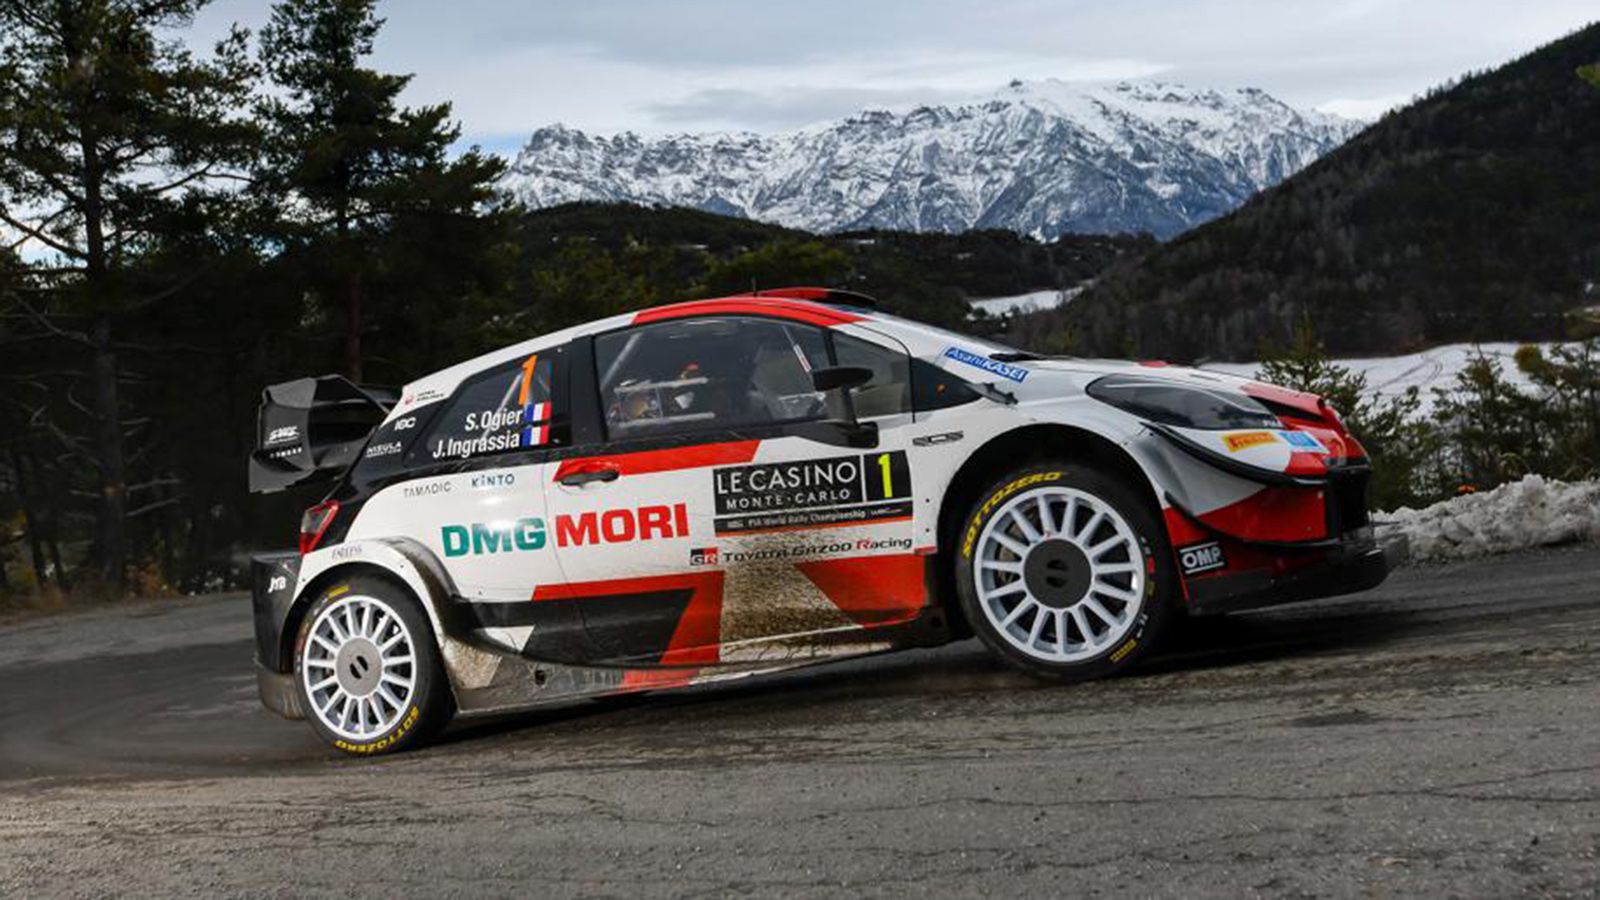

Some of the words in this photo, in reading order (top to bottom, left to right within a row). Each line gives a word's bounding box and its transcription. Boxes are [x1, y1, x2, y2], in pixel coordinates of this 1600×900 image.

[518, 355, 537, 406] 1
[464, 407, 523, 432] S.Ogier
[432, 430, 520, 458] J.Ingrassia
[403, 481, 452, 498] TAMADIC
[716, 472, 743, 494] LE
[749, 461, 857, 491] CASINO
[878, 454, 893, 498] 1
[441, 517, 547, 557] DMG
[555, 503, 689, 547] MORI
[962, 471, 1063, 560] SOTTOZERO
[856, 538, 913, 551] Racing
[1182, 547, 1220, 568] OMP
[335, 706, 420, 754] SOTTOZERO
